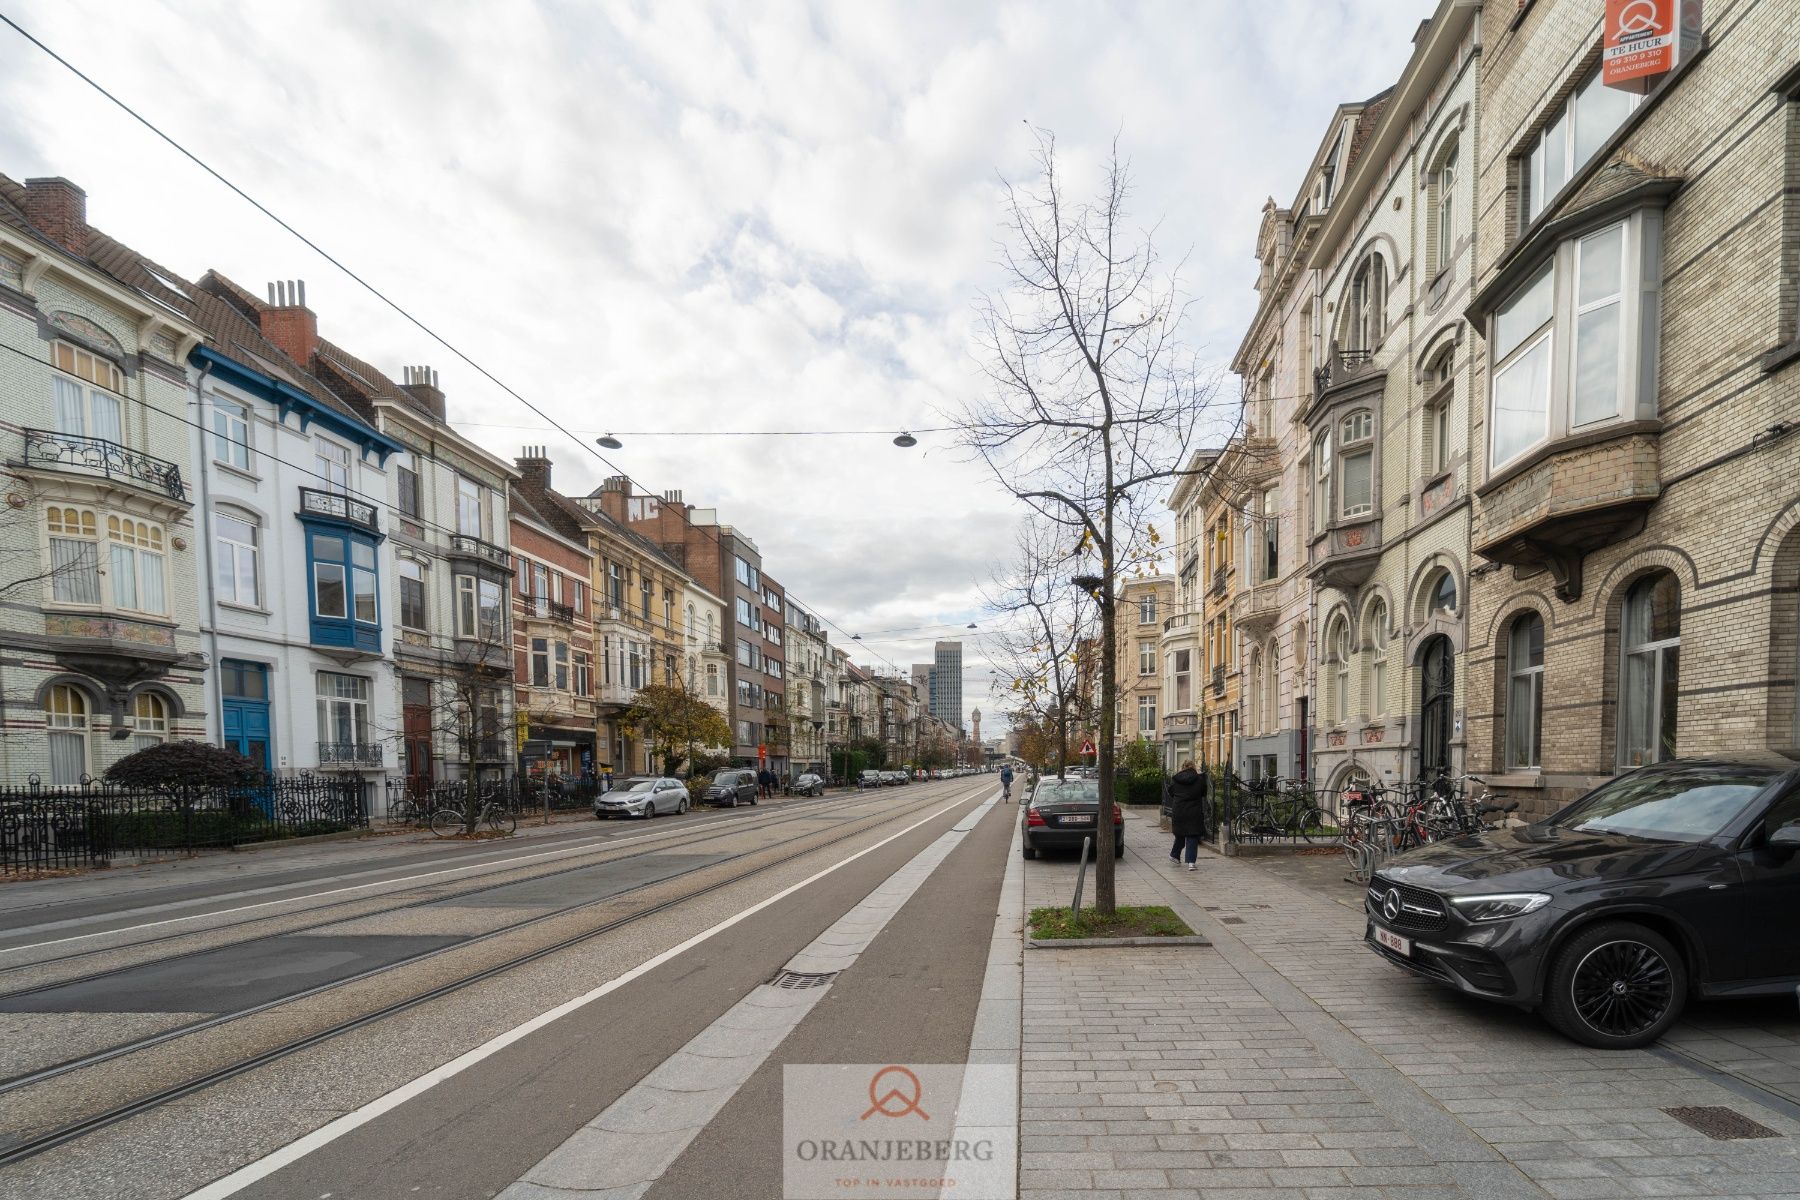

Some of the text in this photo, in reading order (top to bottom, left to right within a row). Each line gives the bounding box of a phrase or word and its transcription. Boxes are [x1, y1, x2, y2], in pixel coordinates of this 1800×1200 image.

[1611, 38, 1662, 56] TE HUUR
[1623, 55, 1638, 64] 310
[1639, 53, 1646, 61] 9
[1647, 49, 1662, 58] 310
[1610, 58, 1661, 75] ORANJEBERG
